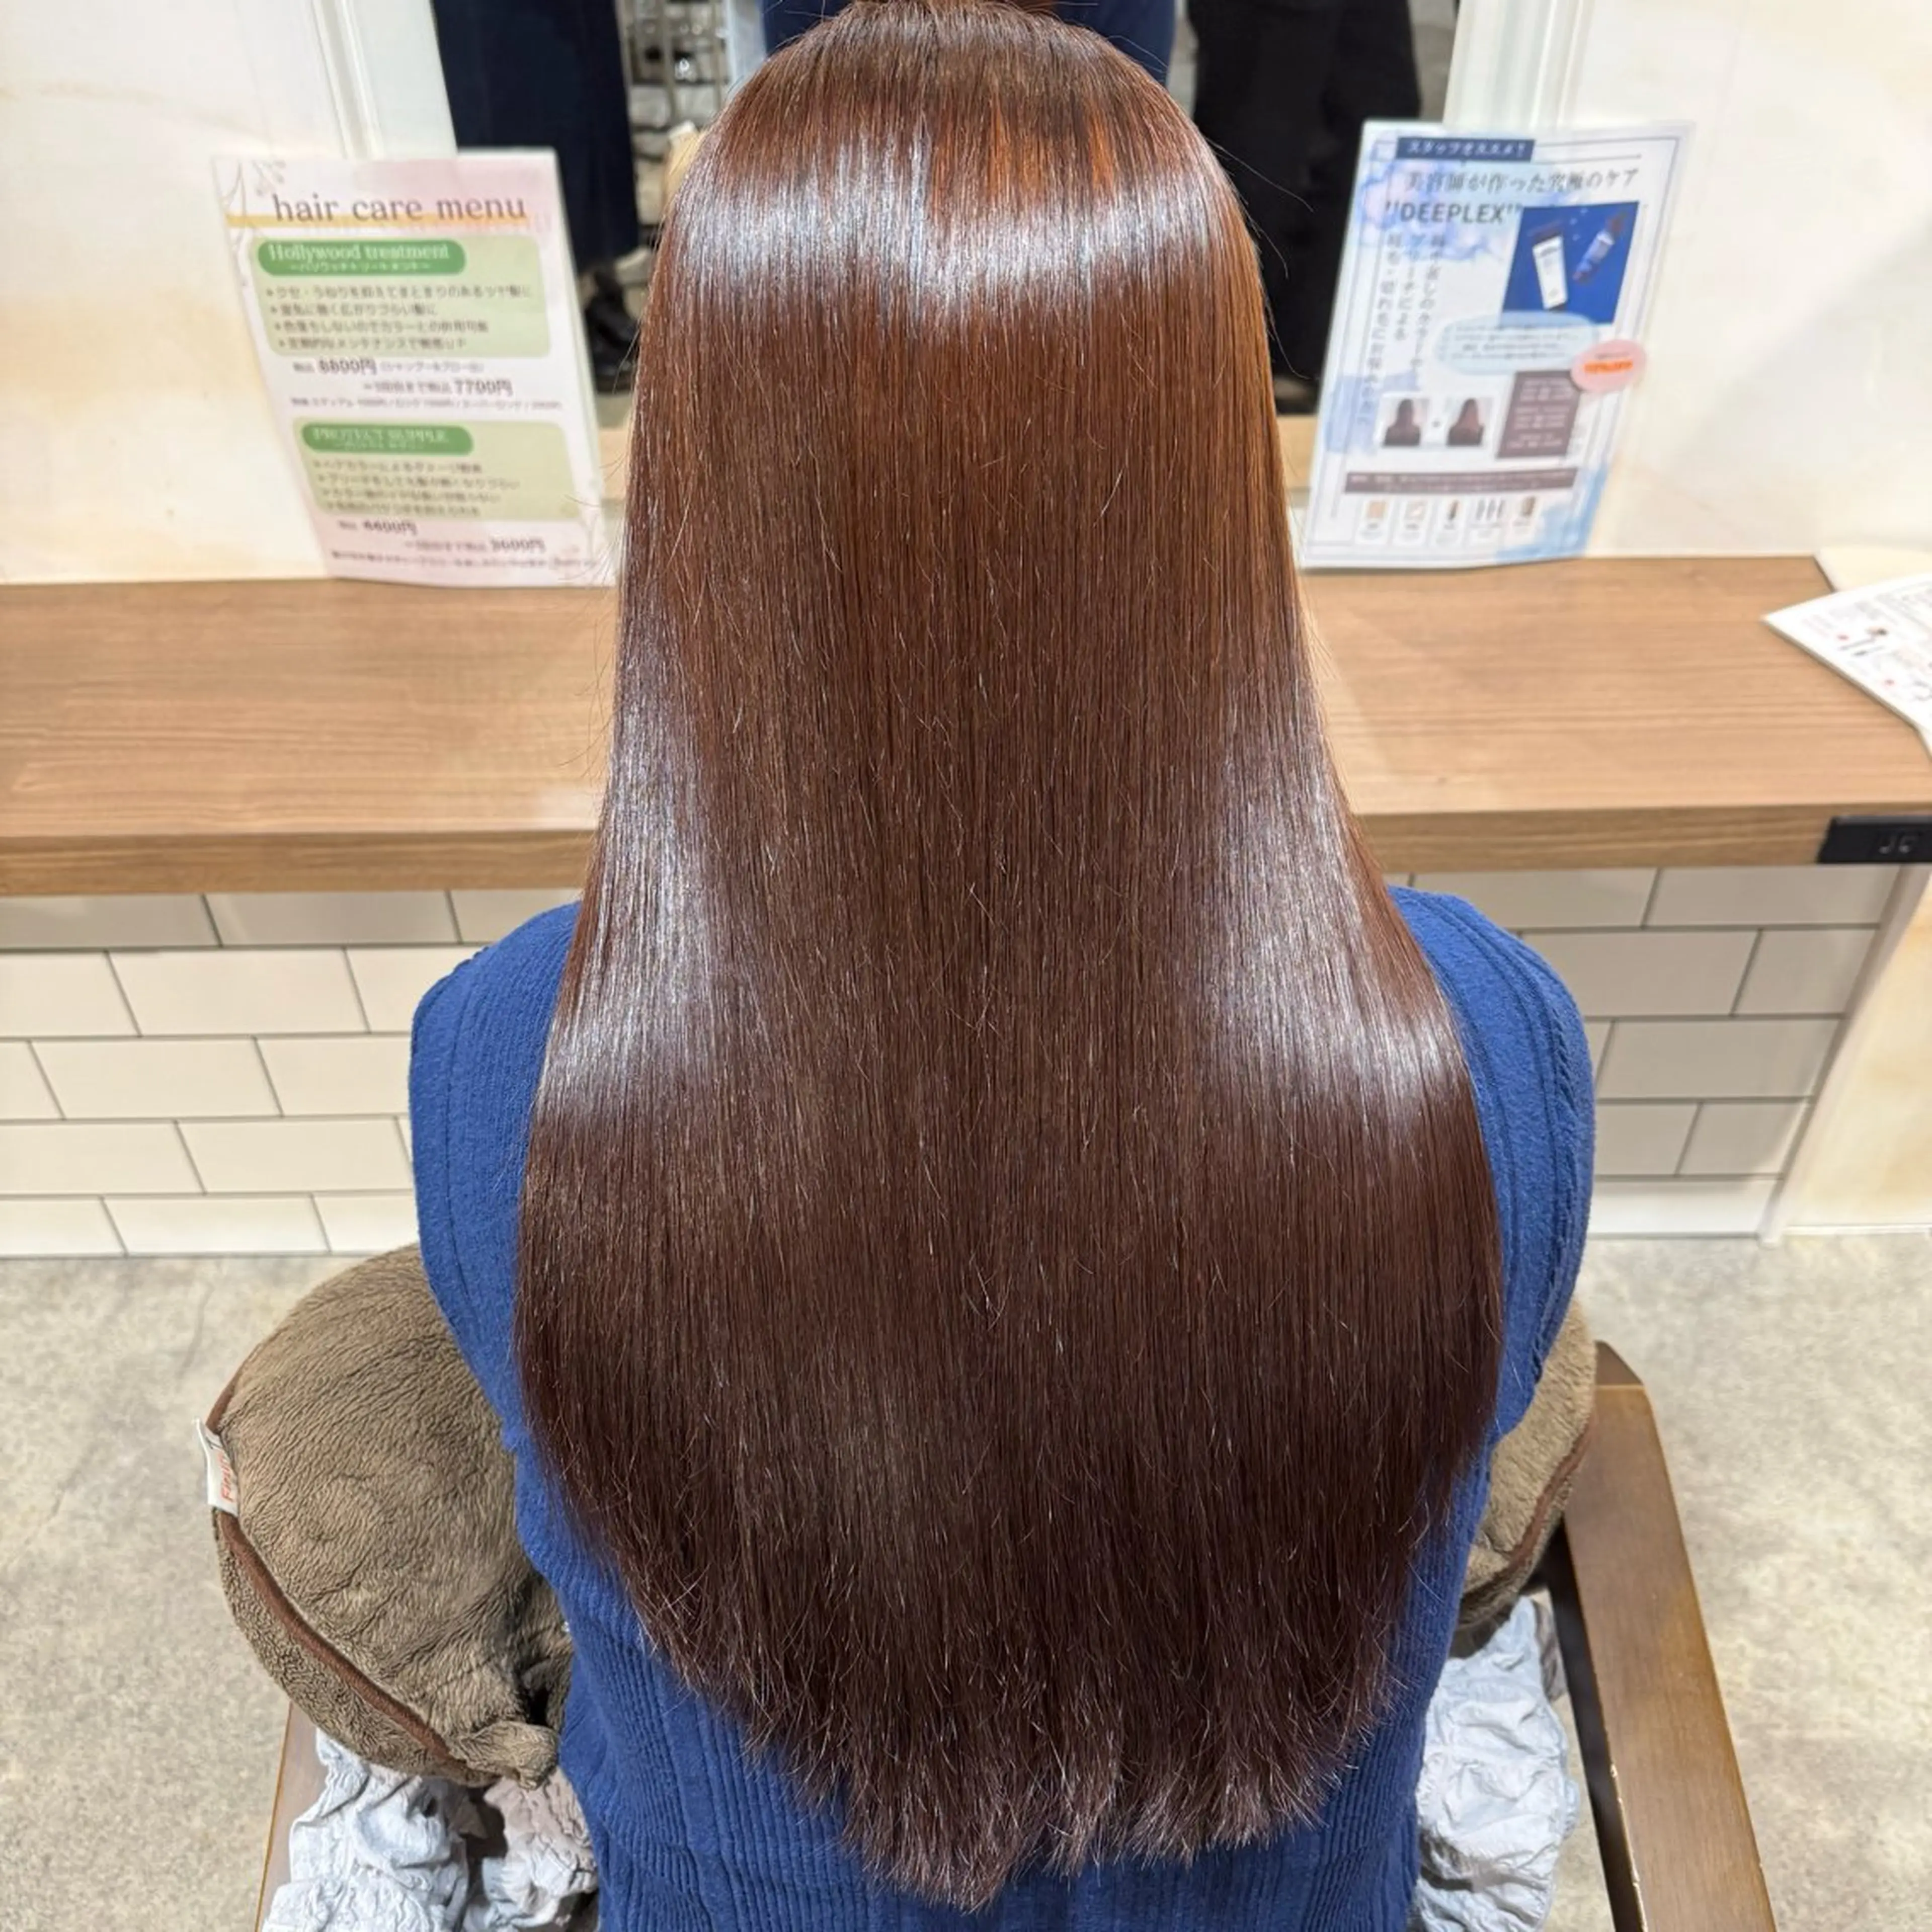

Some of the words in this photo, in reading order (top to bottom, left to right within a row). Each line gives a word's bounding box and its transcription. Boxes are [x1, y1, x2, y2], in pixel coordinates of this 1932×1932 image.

[1405, 169, 1639, 194] 美容師が作った究極のケア
[272, 193, 340, 222] hair
[351, 198, 423, 221] care
[436, 197, 527, 220] menu
[268, 243, 361, 263] Hollywood
[364, 243, 450, 260] treatment
[319, 357, 377, 375] 6600円
[454, 378, 514, 397] 7700円
